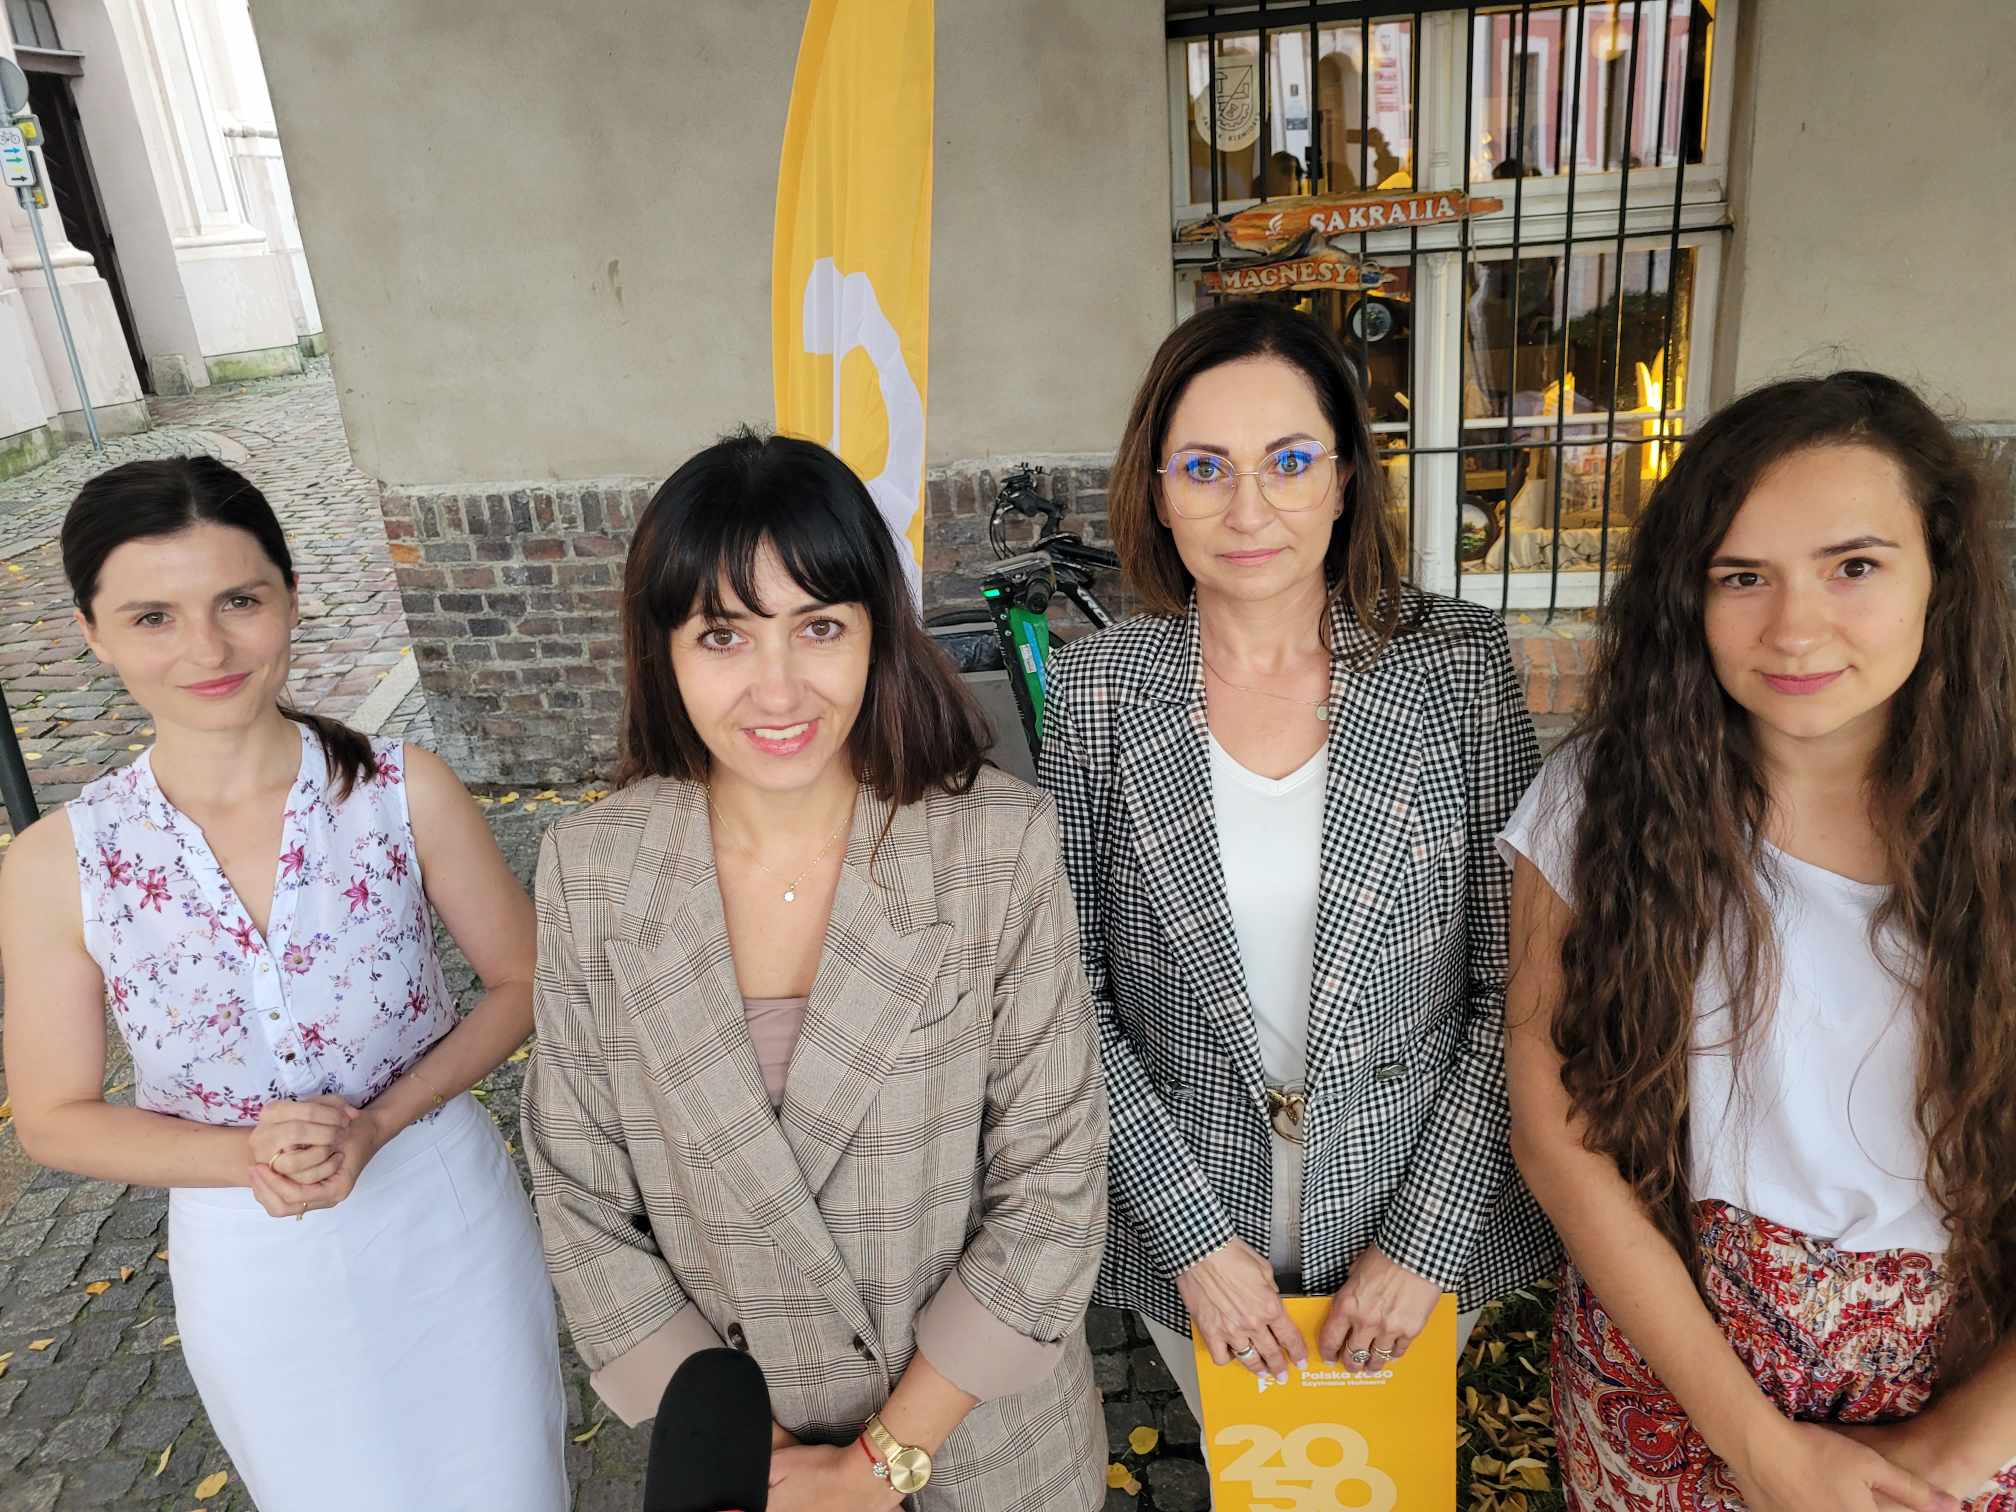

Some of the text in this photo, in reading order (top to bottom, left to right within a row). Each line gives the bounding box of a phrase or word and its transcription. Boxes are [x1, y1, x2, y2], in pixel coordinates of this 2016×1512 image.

[1309, 196, 1455, 232] SAKRALIA
[1219, 262, 1352, 290] MAGNESY
[1301, 1370, 1351, 1380] Polska
[1214, 1423, 1369, 1482] 20
